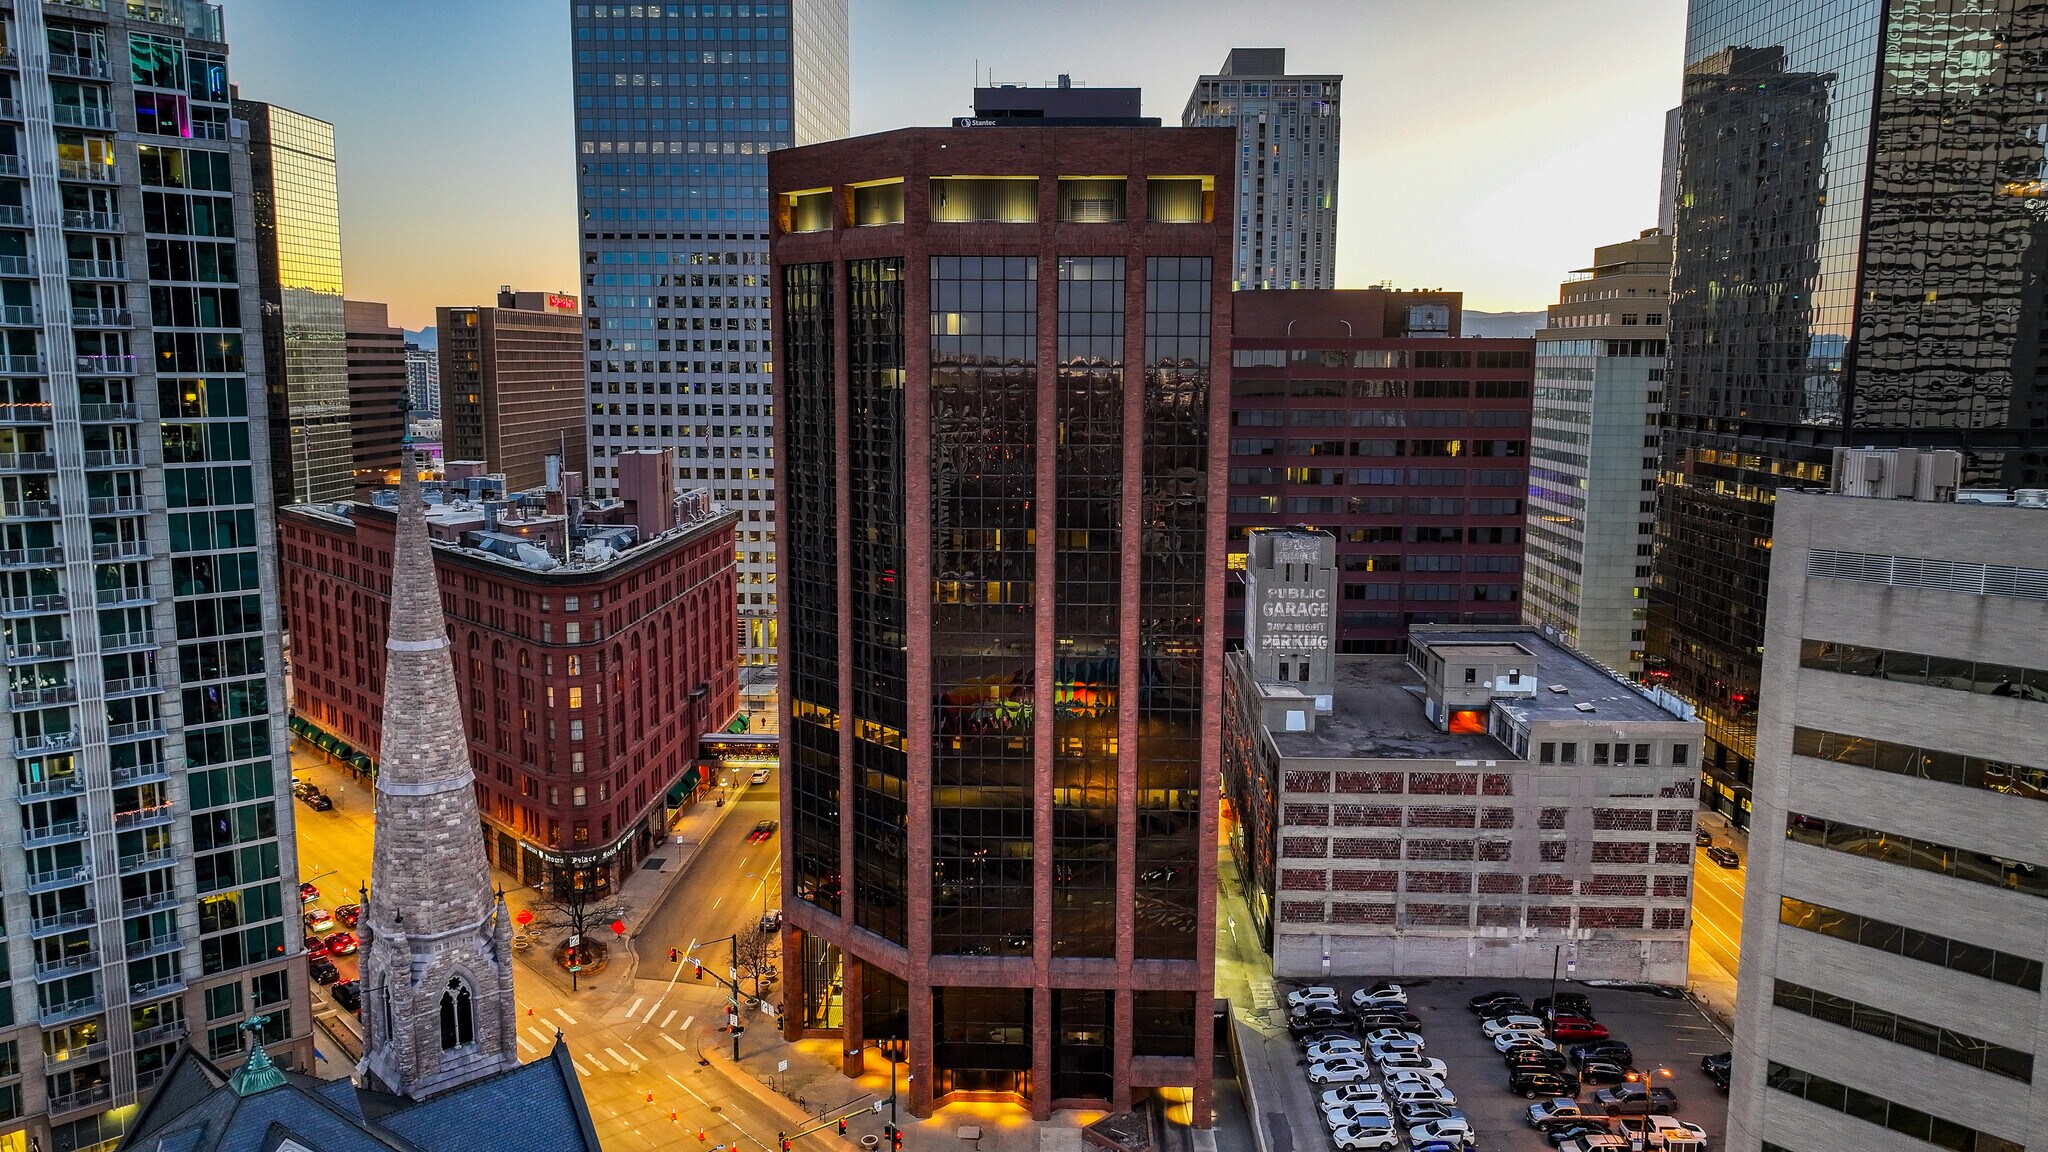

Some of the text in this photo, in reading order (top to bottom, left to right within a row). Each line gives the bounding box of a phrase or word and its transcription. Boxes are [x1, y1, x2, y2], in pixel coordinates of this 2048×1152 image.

[1267, 588, 1326, 599] PUBLIC
[1262, 602, 1329, 617] GARAGE
[1294, 622, 1326, 632] NIGHT
[1262, 634, 1329, 650] PARKING
[571, 855, 597, 864] Palace
